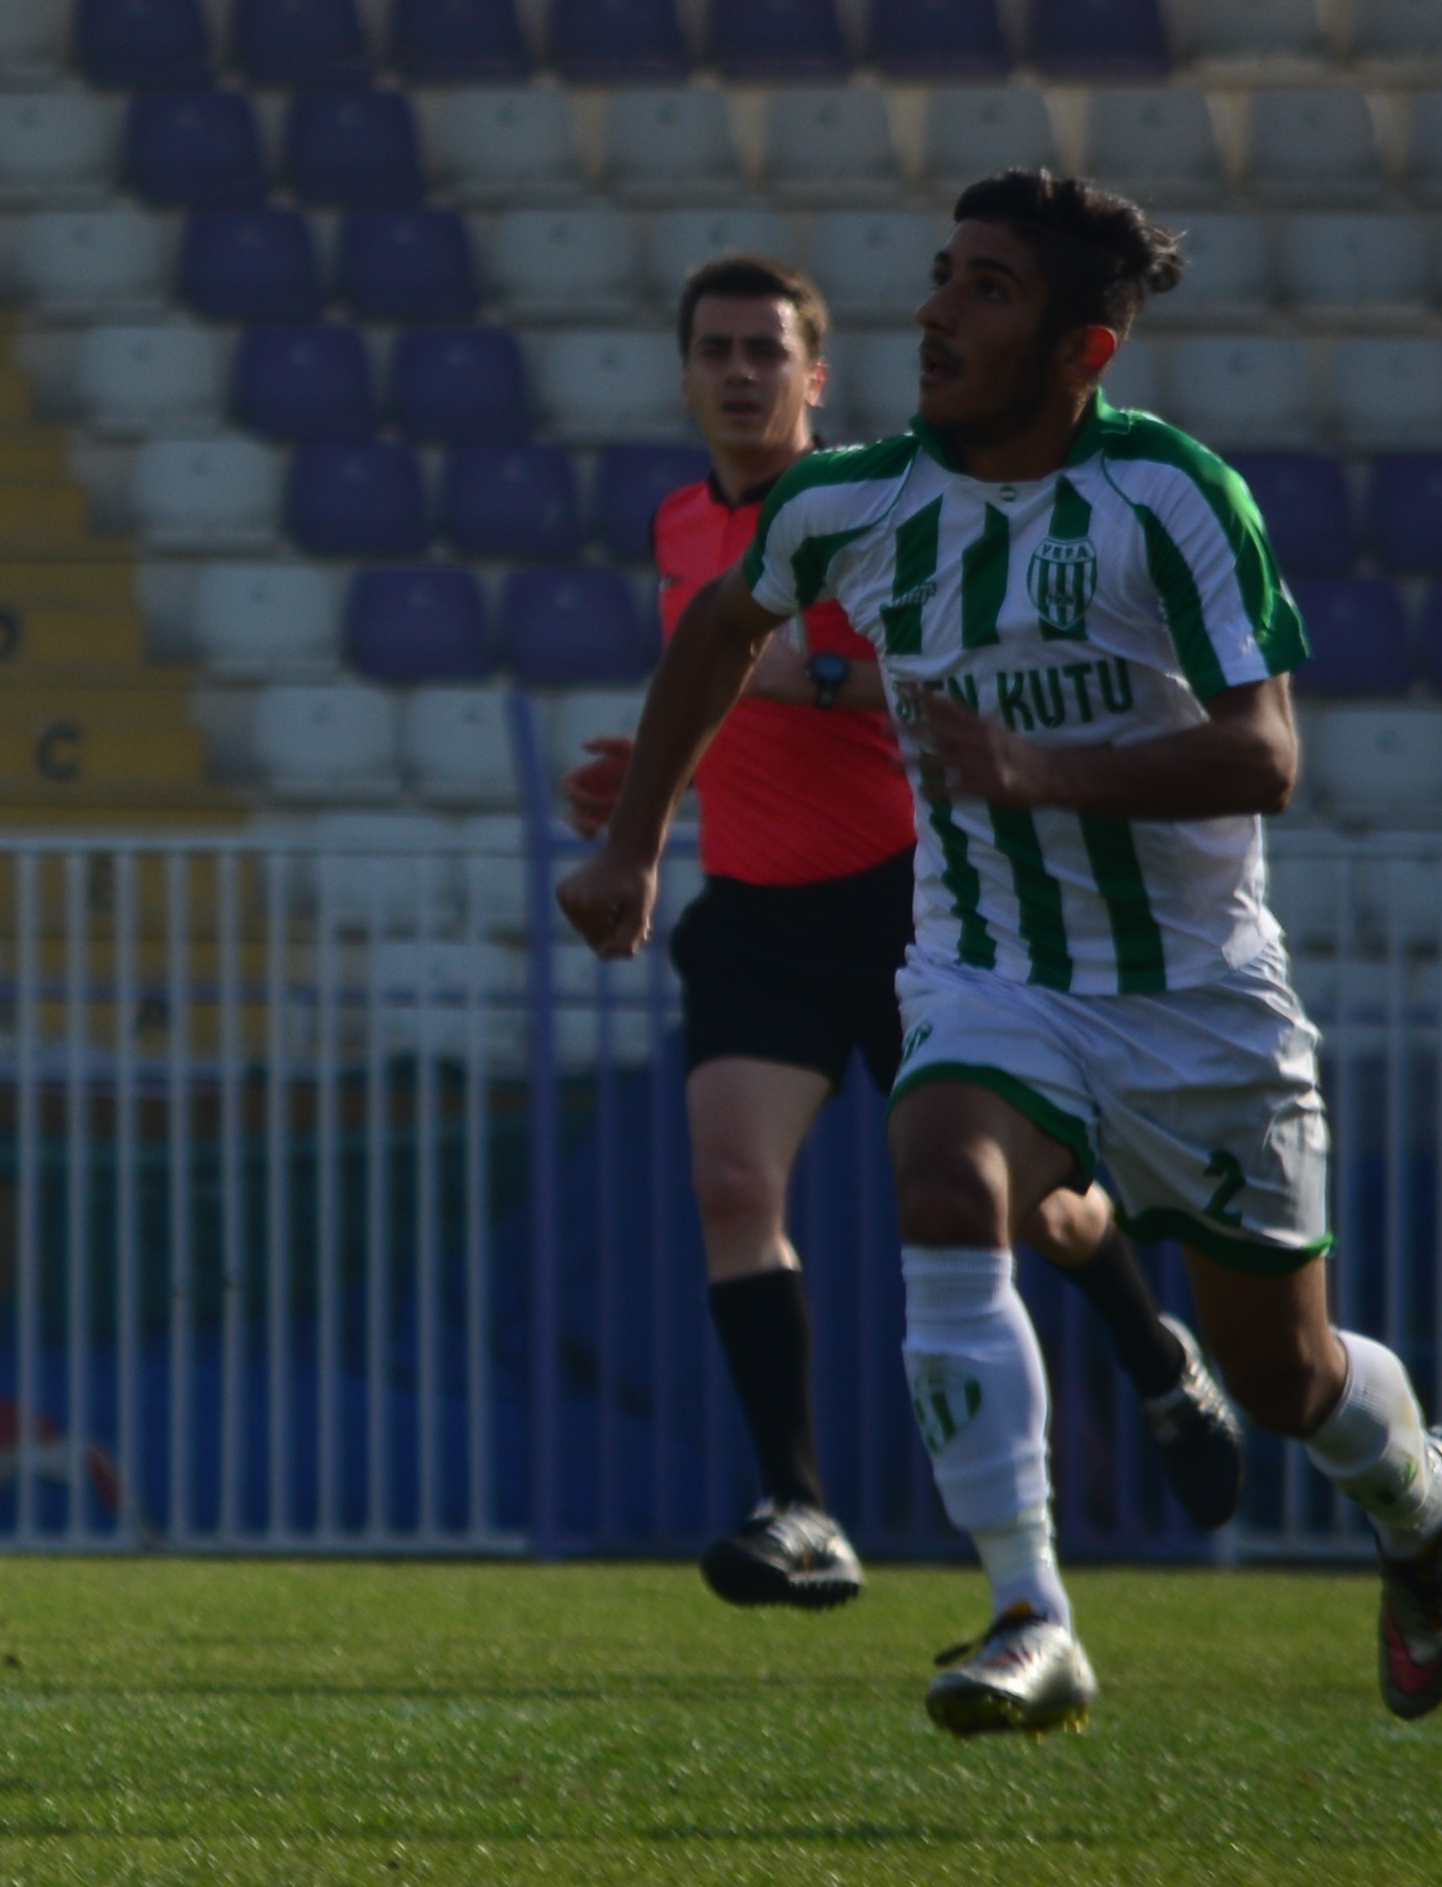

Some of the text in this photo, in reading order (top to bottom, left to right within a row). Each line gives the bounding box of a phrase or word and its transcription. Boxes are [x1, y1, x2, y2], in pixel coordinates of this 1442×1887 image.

[998, 656, 1135, 731] KUTU
[34, 721, 82, 781] C
[1203, 1151, 1246, 1227] 2
